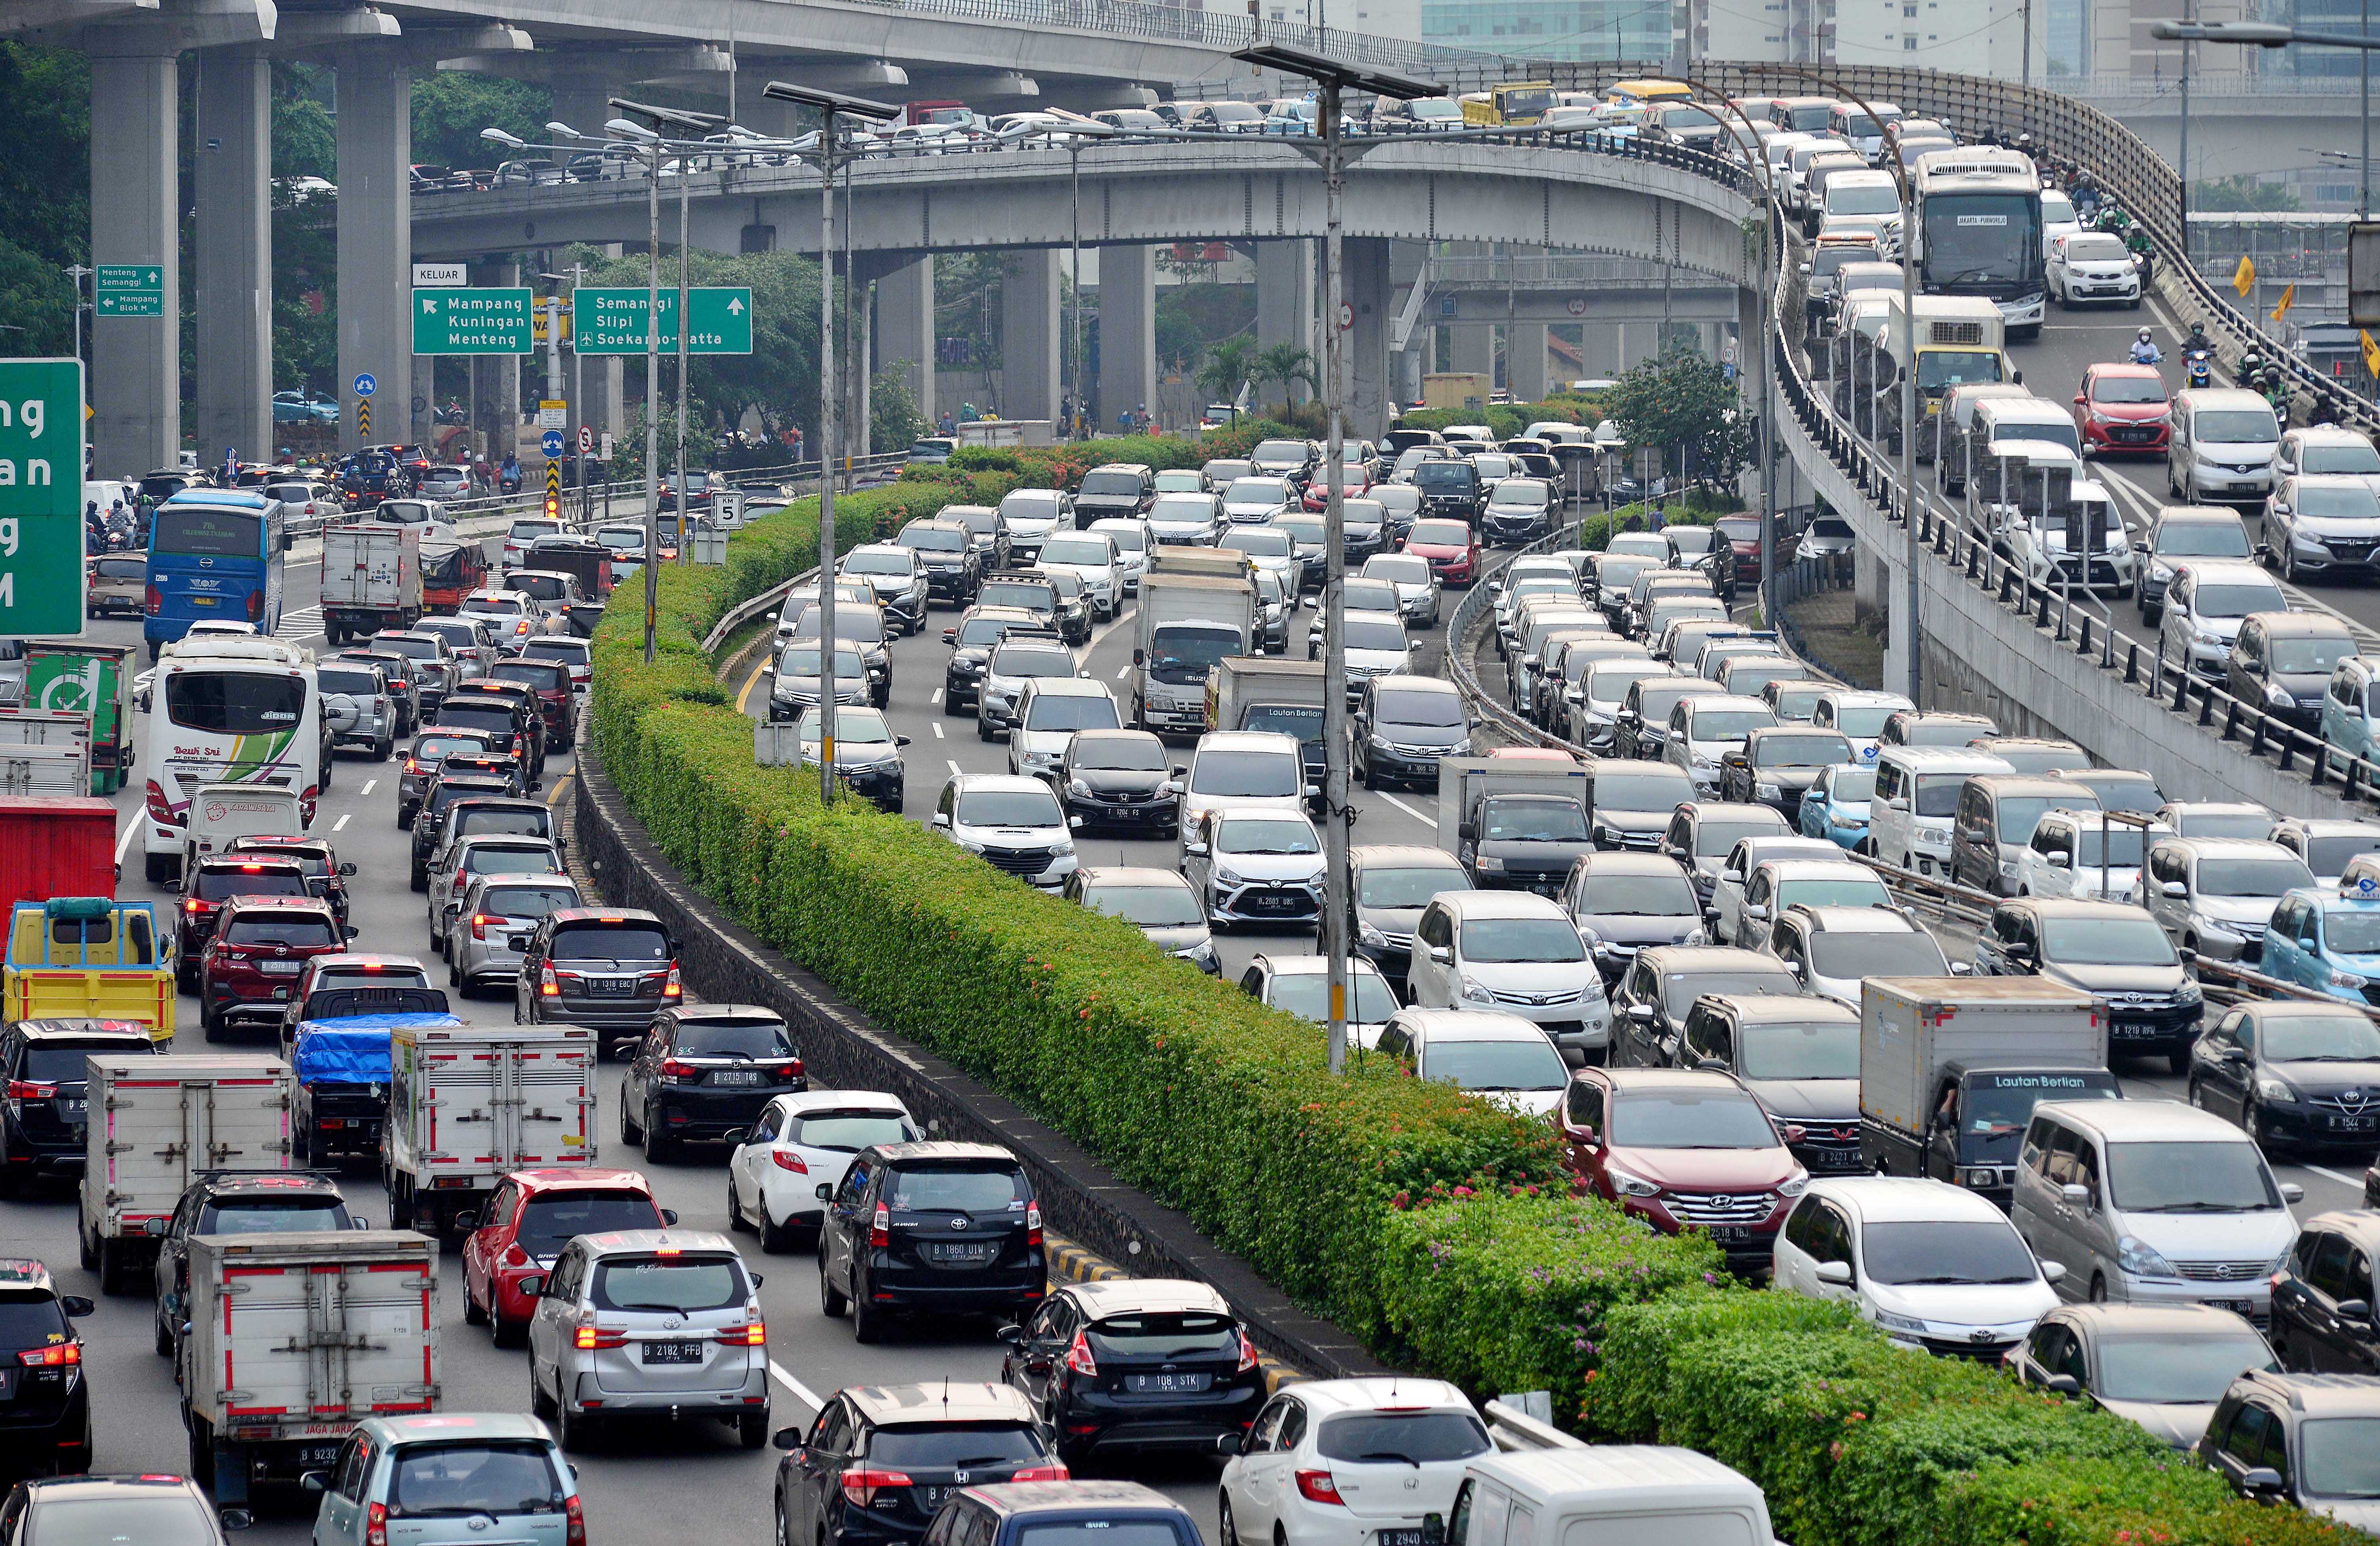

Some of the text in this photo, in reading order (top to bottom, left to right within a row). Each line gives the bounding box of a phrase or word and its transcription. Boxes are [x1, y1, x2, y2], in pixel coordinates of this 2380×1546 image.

[420, 271, 458, 279] KELUAR
[448, 298, 522, 312] Mampang
[596, 297, 671, 312] Semangi
[448, 316, 525, 330] Kuningan
[596, 315, 633, 329] Slipi
[448, 333, 516, 348] Menteng
[597, 333, 722, 345] Soekao-atta
[722, 506, 733, 520] 5
[1270, 708, 1322, 717] Lautan Berlian
[204, 746, 221, 756] Sri
[229, 803, 276, 812] TARAWISATA
[714, 1072, 718, 1080] B
[724, 1072, 740, 1080] 2715
[1995, 1075, 2085, 1088] Lautan Berlian
[69, 1099, 74, 1108] B
[1821, 1153, 1825, 1161] B
[1830, 1153, 1847, 1161] 2421
[1711, 1227, 1749, 1238] 2518 TBJ
[935, 1244, 983, 1254] B 1860 UIW
[644, 1345, 650, 1356] B
[657, 1345, 678, 1356] 2182
[1140, 1375, 1196, 1385] B 108 STK
[305, 1425, 327, 1435] JAGA
[302, 1449, 335, 1460] B 9232
[930, 1488, 936, 1500] B
[1384, 1534, 1420, 1546] B 2940
